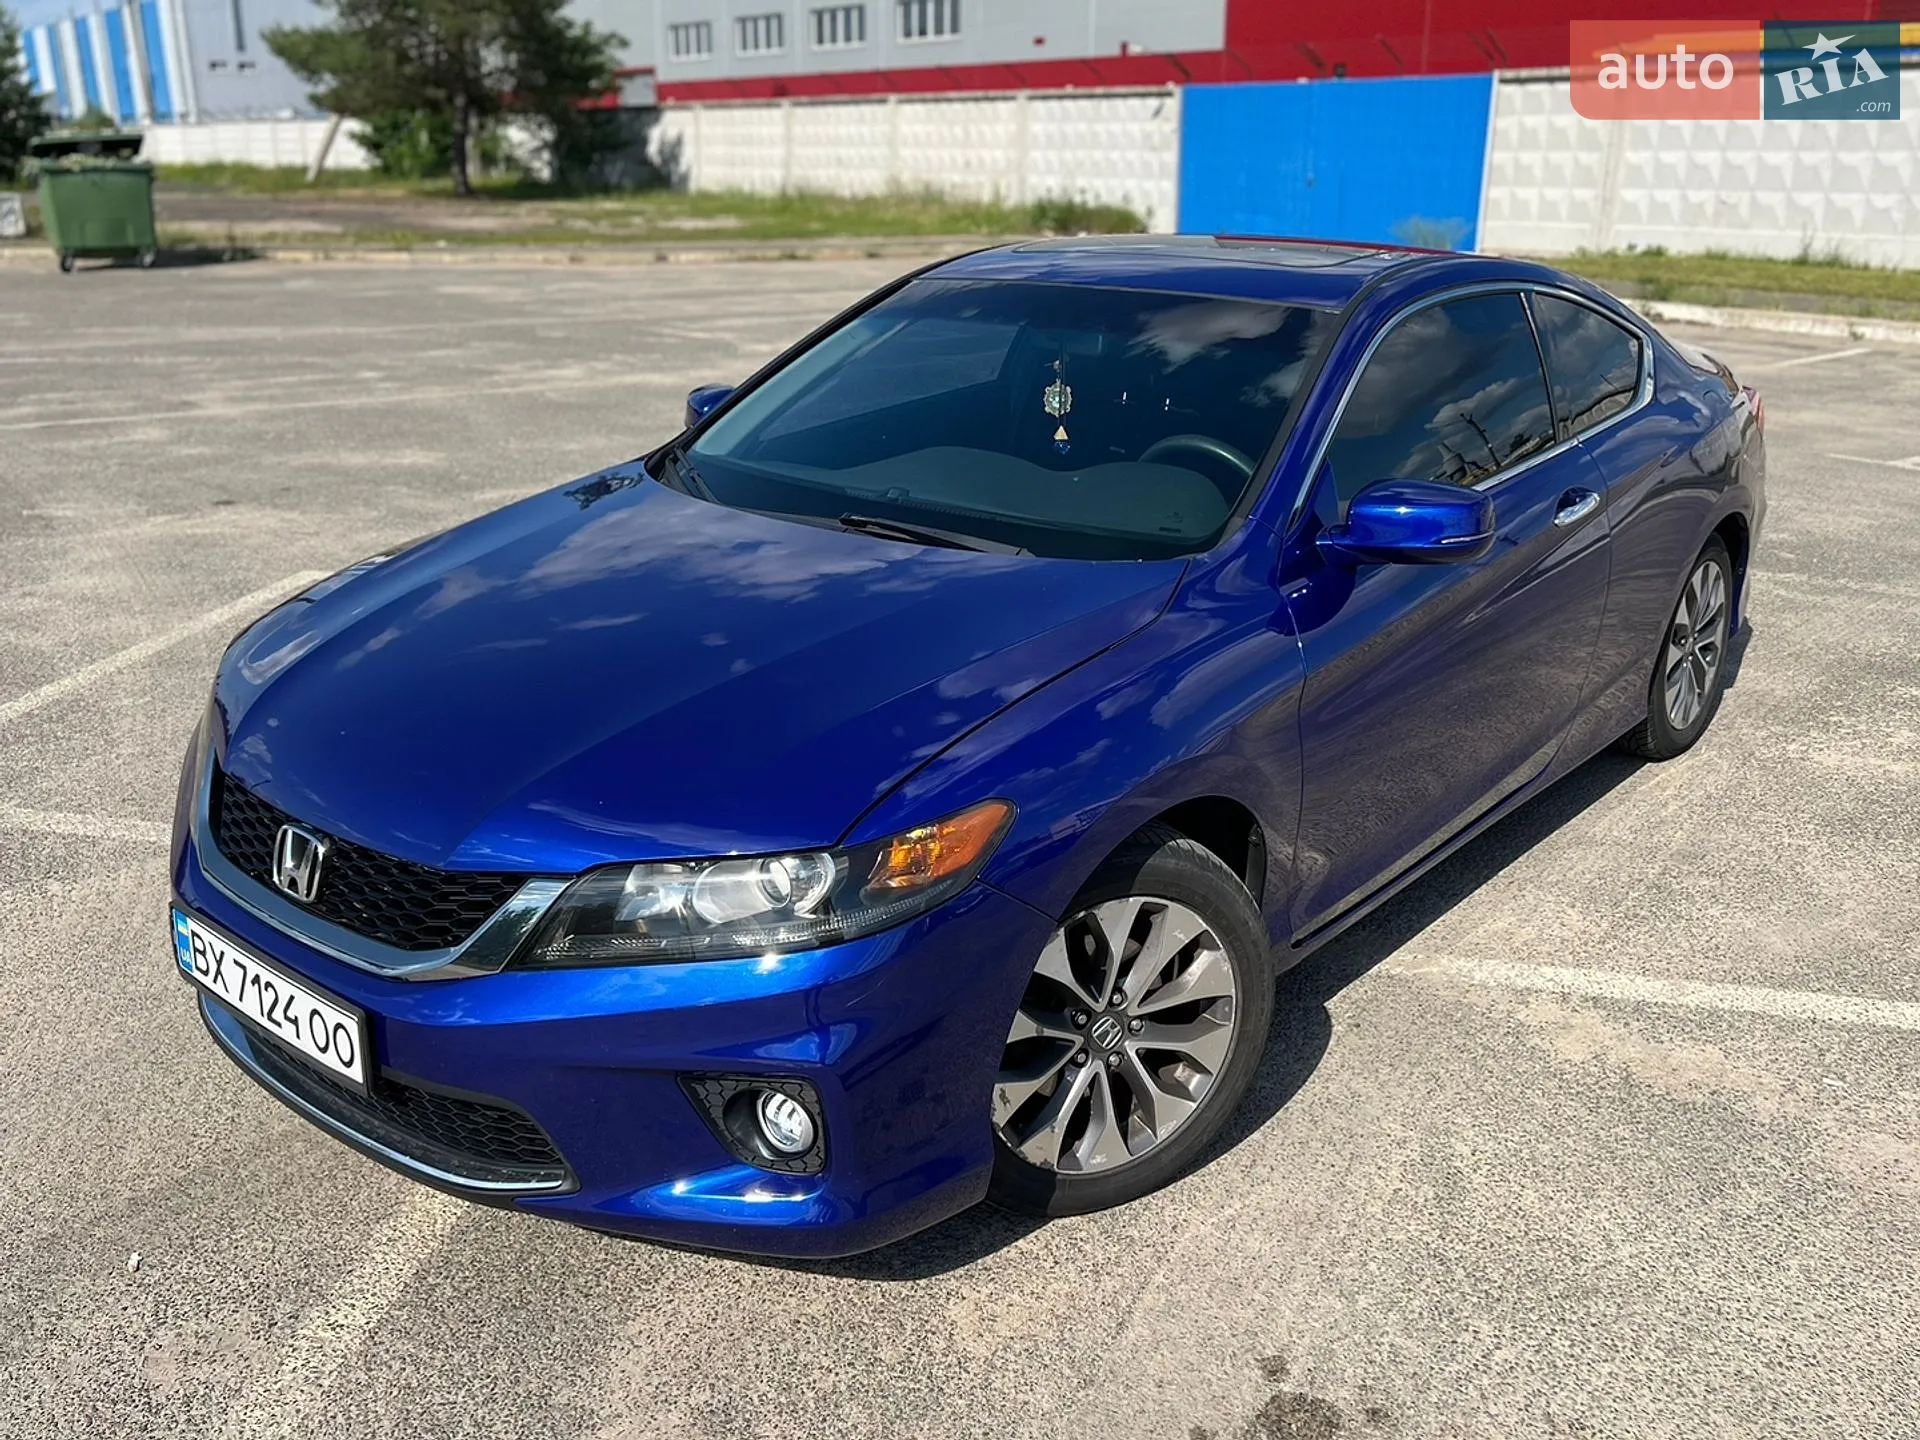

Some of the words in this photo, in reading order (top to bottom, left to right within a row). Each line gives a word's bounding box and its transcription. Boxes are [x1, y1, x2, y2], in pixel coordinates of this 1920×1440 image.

[180, 946, 192, 966] UA
[190, 929, 230, 994] BX
[233, 958, 301, 1041] 7124
[309, 1008, 355, 1069] OO
